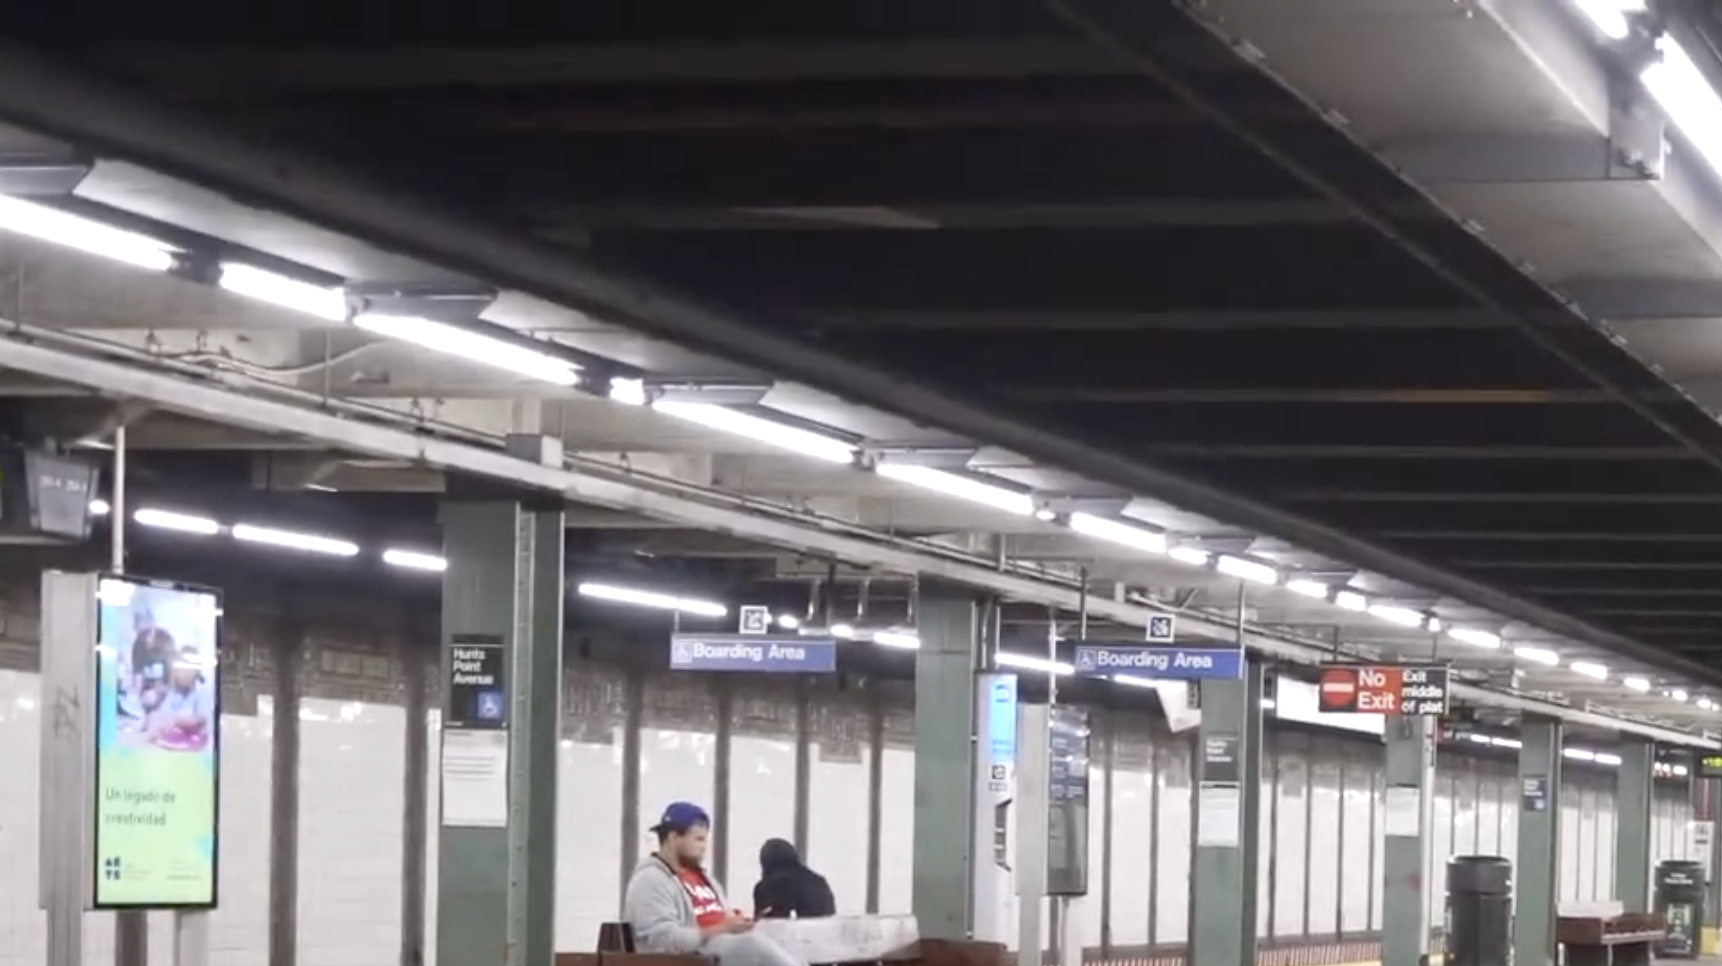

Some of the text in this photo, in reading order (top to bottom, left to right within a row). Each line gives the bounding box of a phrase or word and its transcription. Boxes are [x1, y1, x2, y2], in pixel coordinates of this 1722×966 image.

[453, 647, 485, 660] Hunts
[693, 642, 806, 662] Boarding Area
[453, 660, 481, 673] Point
[1097, 650, 1213, 670] Boarding Area
[453, 673, 494, 686] Avenue
[1359, 669, 1387, 688] No
[1402, 670, 1427, 683] Exit
[1402, 686, 1443, 699] middle
[1358, 691, 1396, 710] Exit
[1401, 700, 1416, 713] of
